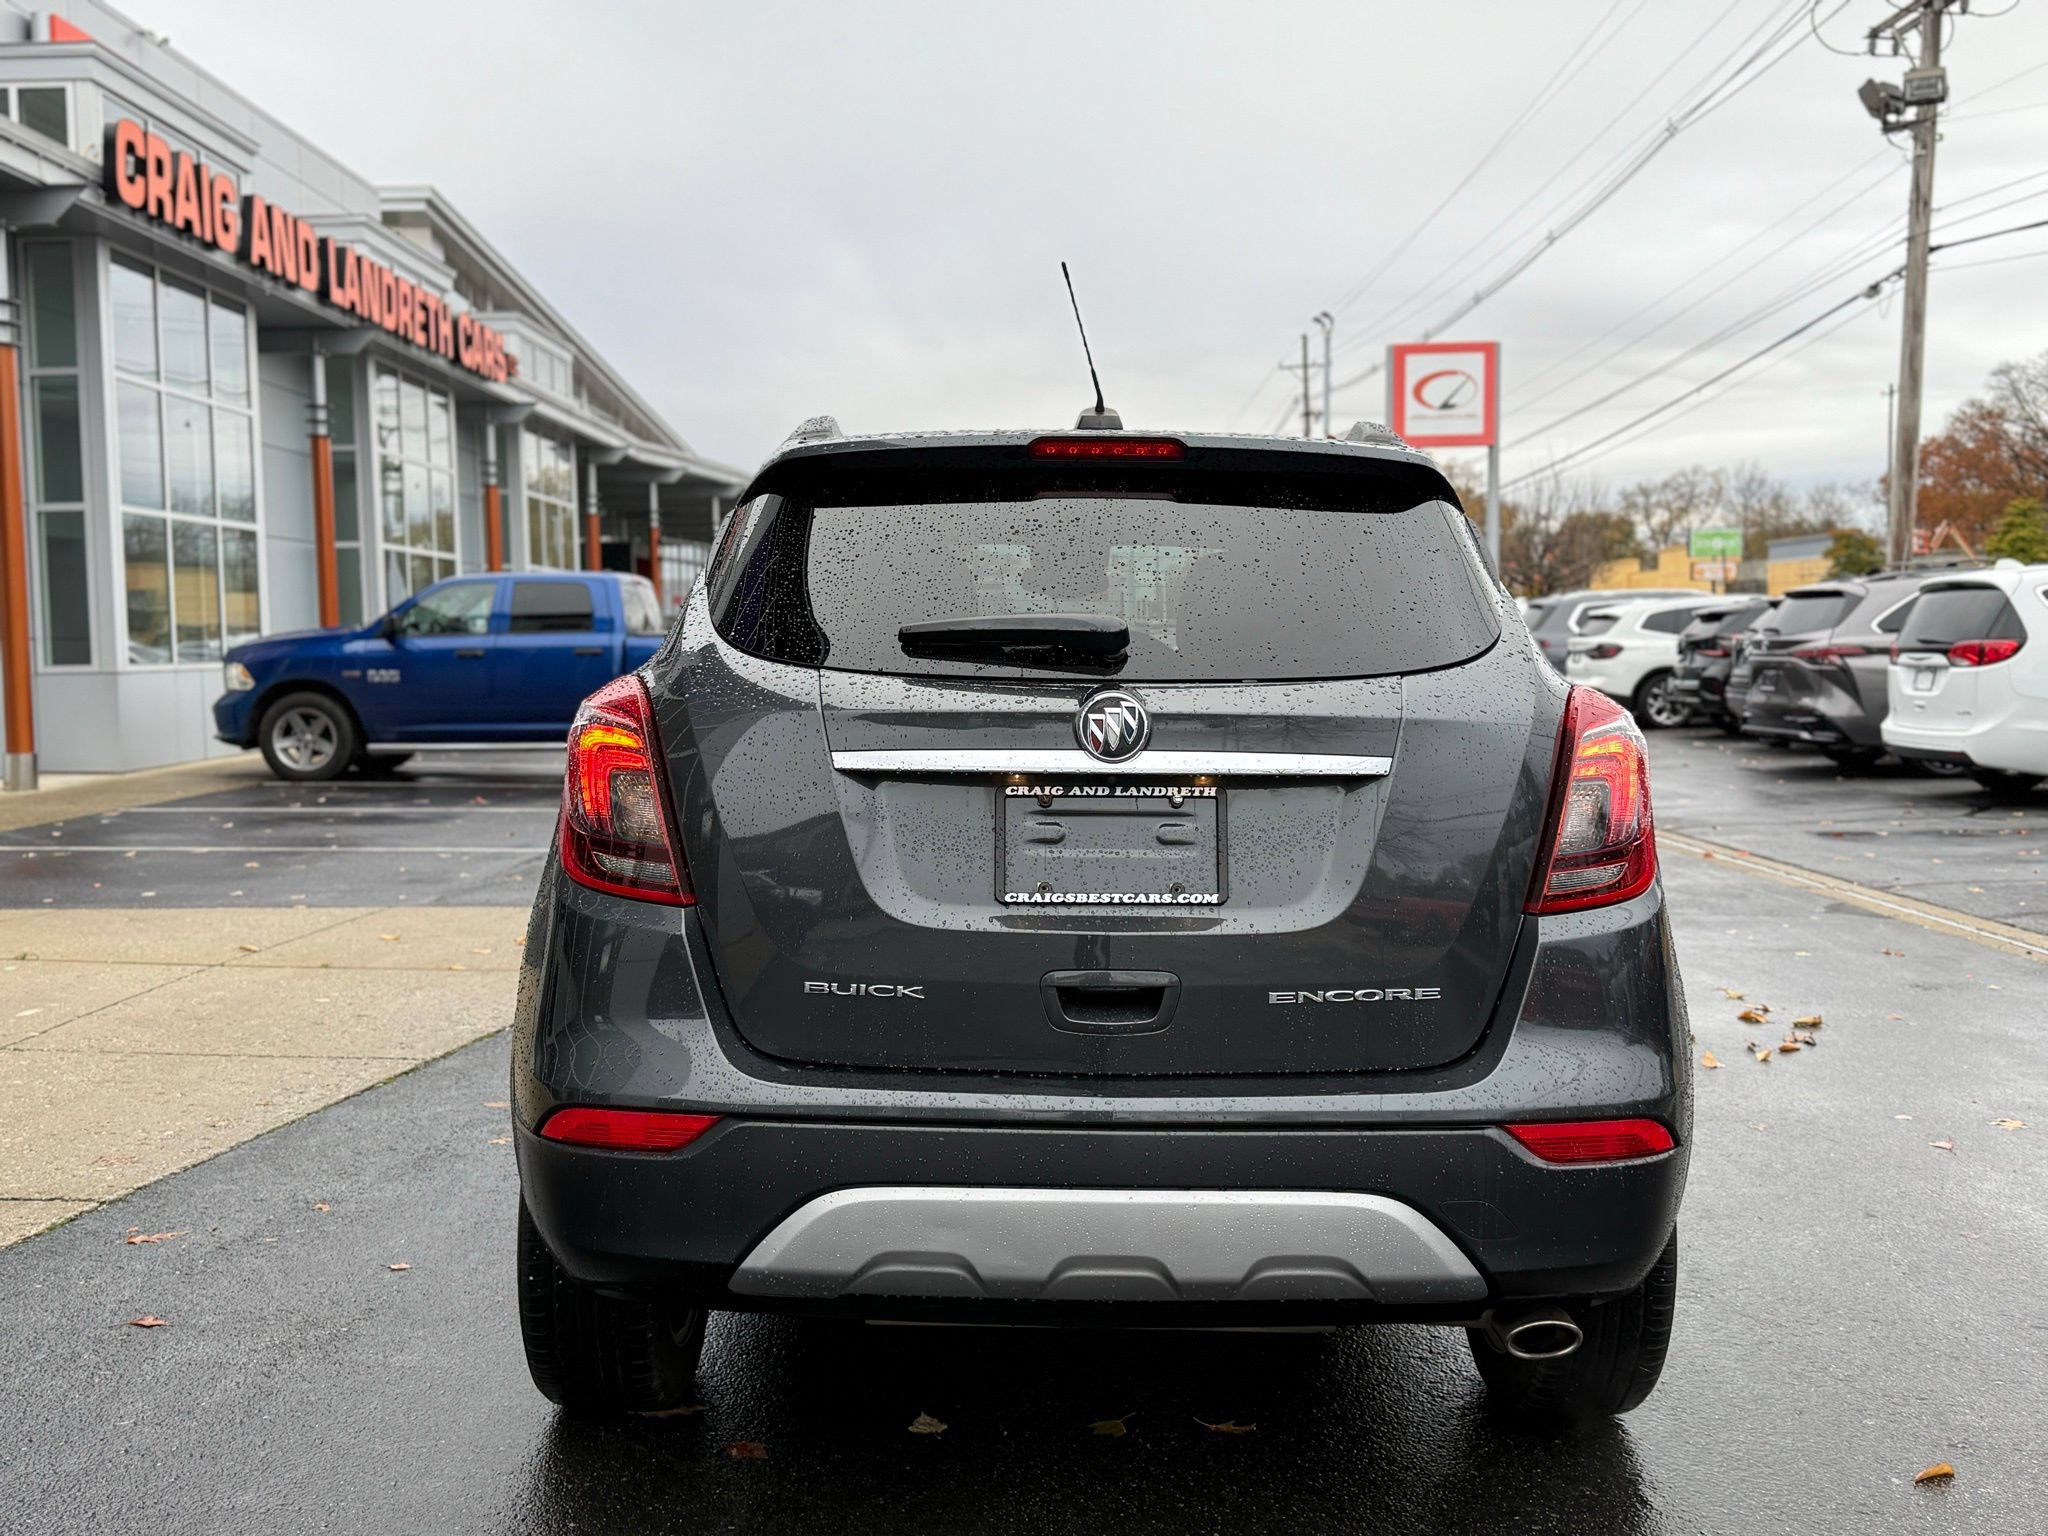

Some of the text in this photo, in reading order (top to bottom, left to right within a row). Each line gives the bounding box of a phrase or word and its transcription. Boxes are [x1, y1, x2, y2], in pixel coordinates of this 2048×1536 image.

[113, 118, 507, 384] CRAIG AND LANDRETH CARS
[1005, 785, 1218, 797] CRAIG AND LANDRETH
[1004, 892, 1219, 904] CRAIGSBESTCARS.COM
[803, 981, 926, 999] BUICK
[1268, 987, 1442, 1004] ENCORE
